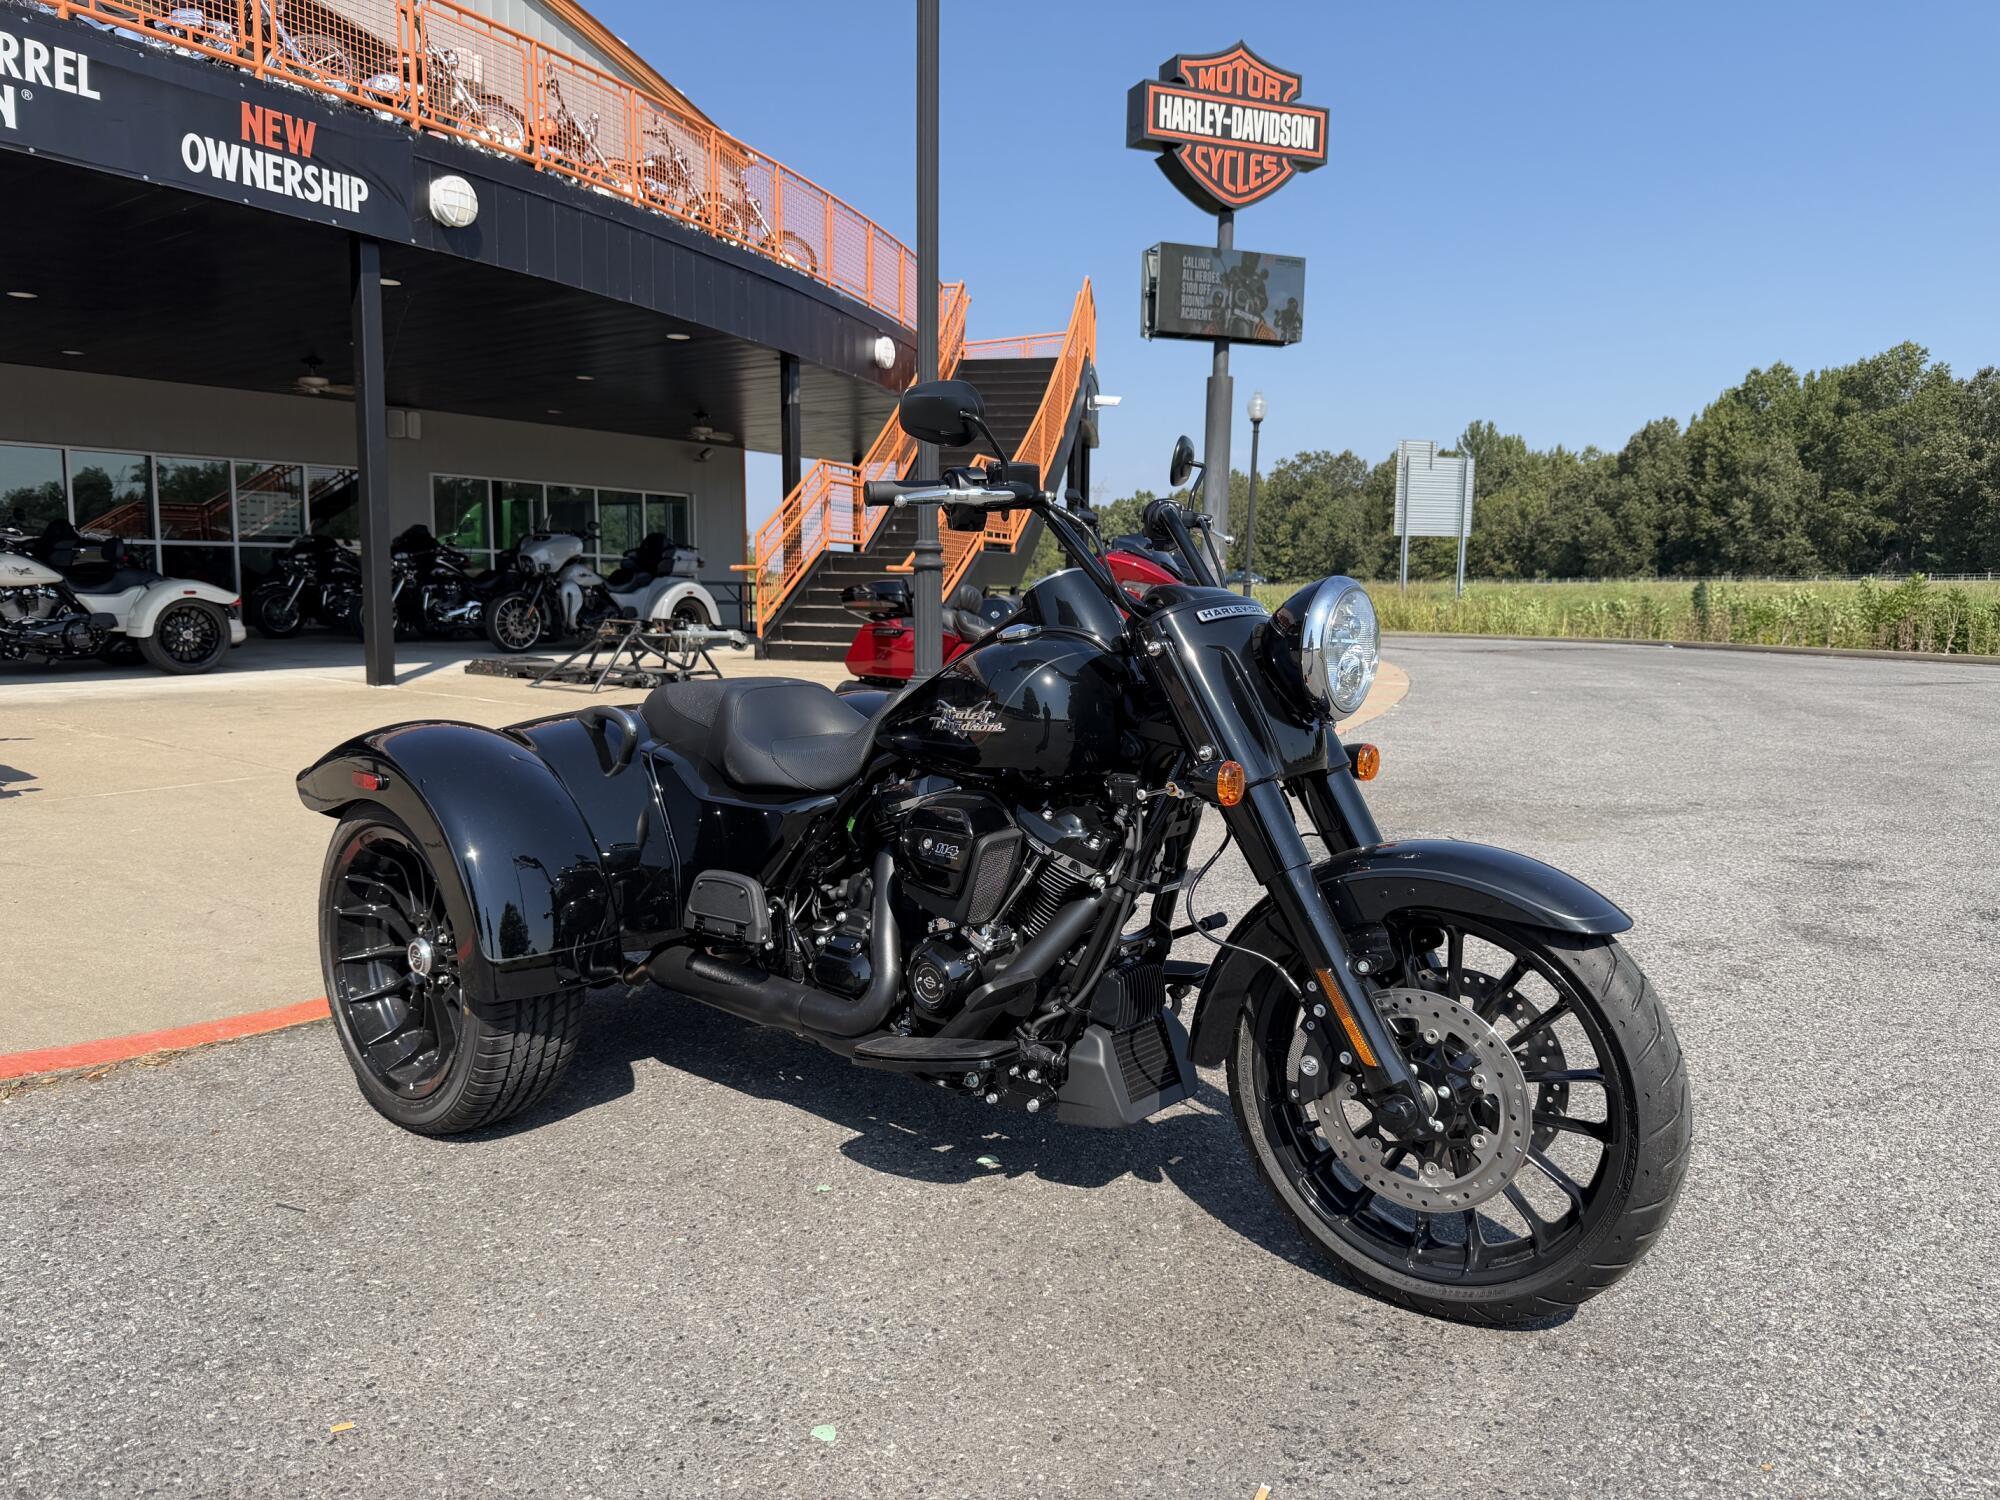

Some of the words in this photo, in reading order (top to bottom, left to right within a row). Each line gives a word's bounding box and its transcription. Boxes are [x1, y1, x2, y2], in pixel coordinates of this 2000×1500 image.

[0, 30, 101, 101] RREL
[1198, 58, 1281, 102] MOTOR
[240, 101, 317, 158] NEW
[1158, 94, 1315, 150] HARLEY-DAVIDSON
[181, 132, 369, 213] OWNERSHIP
[1182, 255, 1210, 270] CALLING
[1182, 269, 1194, 281] ALL
[1181, 294, 1205, 308] RIDING
[1199, 283, 1211, 296] OFF
[934, 842, 960, 857] 114
